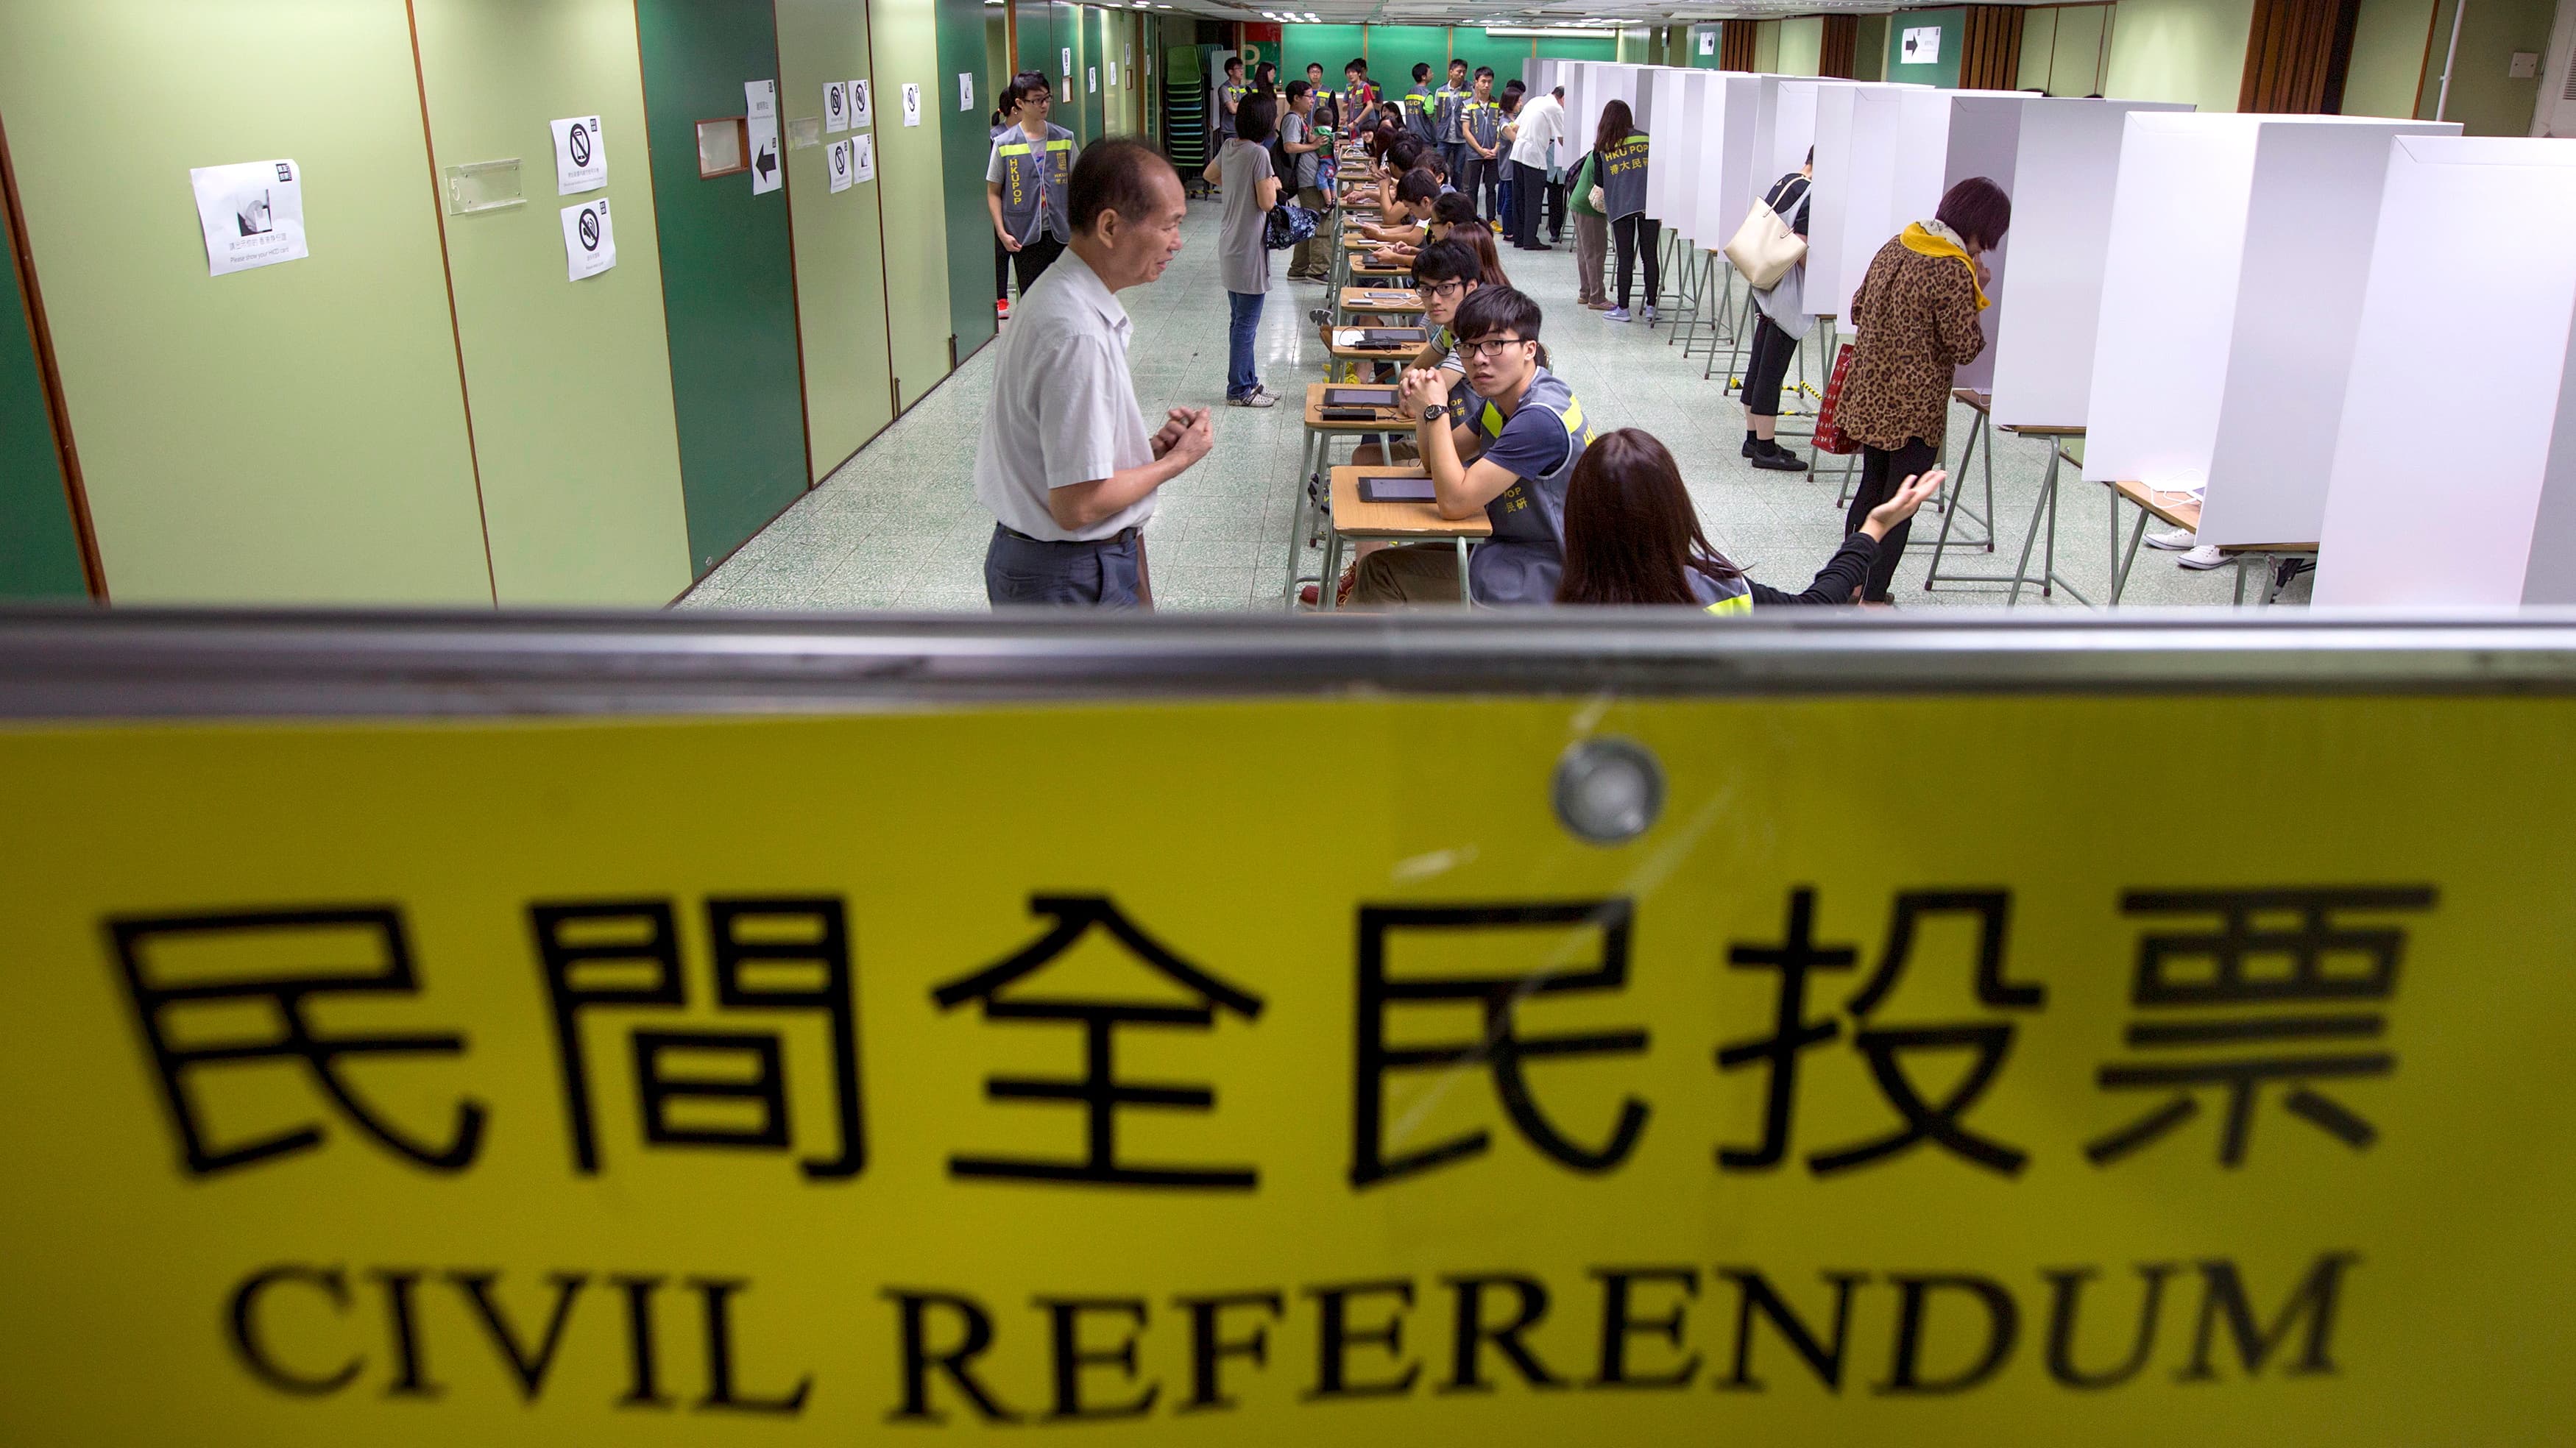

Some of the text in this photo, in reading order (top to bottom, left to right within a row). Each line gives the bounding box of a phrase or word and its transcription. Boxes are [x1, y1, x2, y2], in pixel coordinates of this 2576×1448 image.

[1605, 144, 1649, 162] HKU POP
[450, 177, 460, 201] 5
[1010, 158, 1022, 205] HKUPOP
[258, 252, 267, 260] your
[103, 887, 2441, 1190] 民間全民投票
[224, 1251, 2363, 1427] CIVIL REFERENDUM
